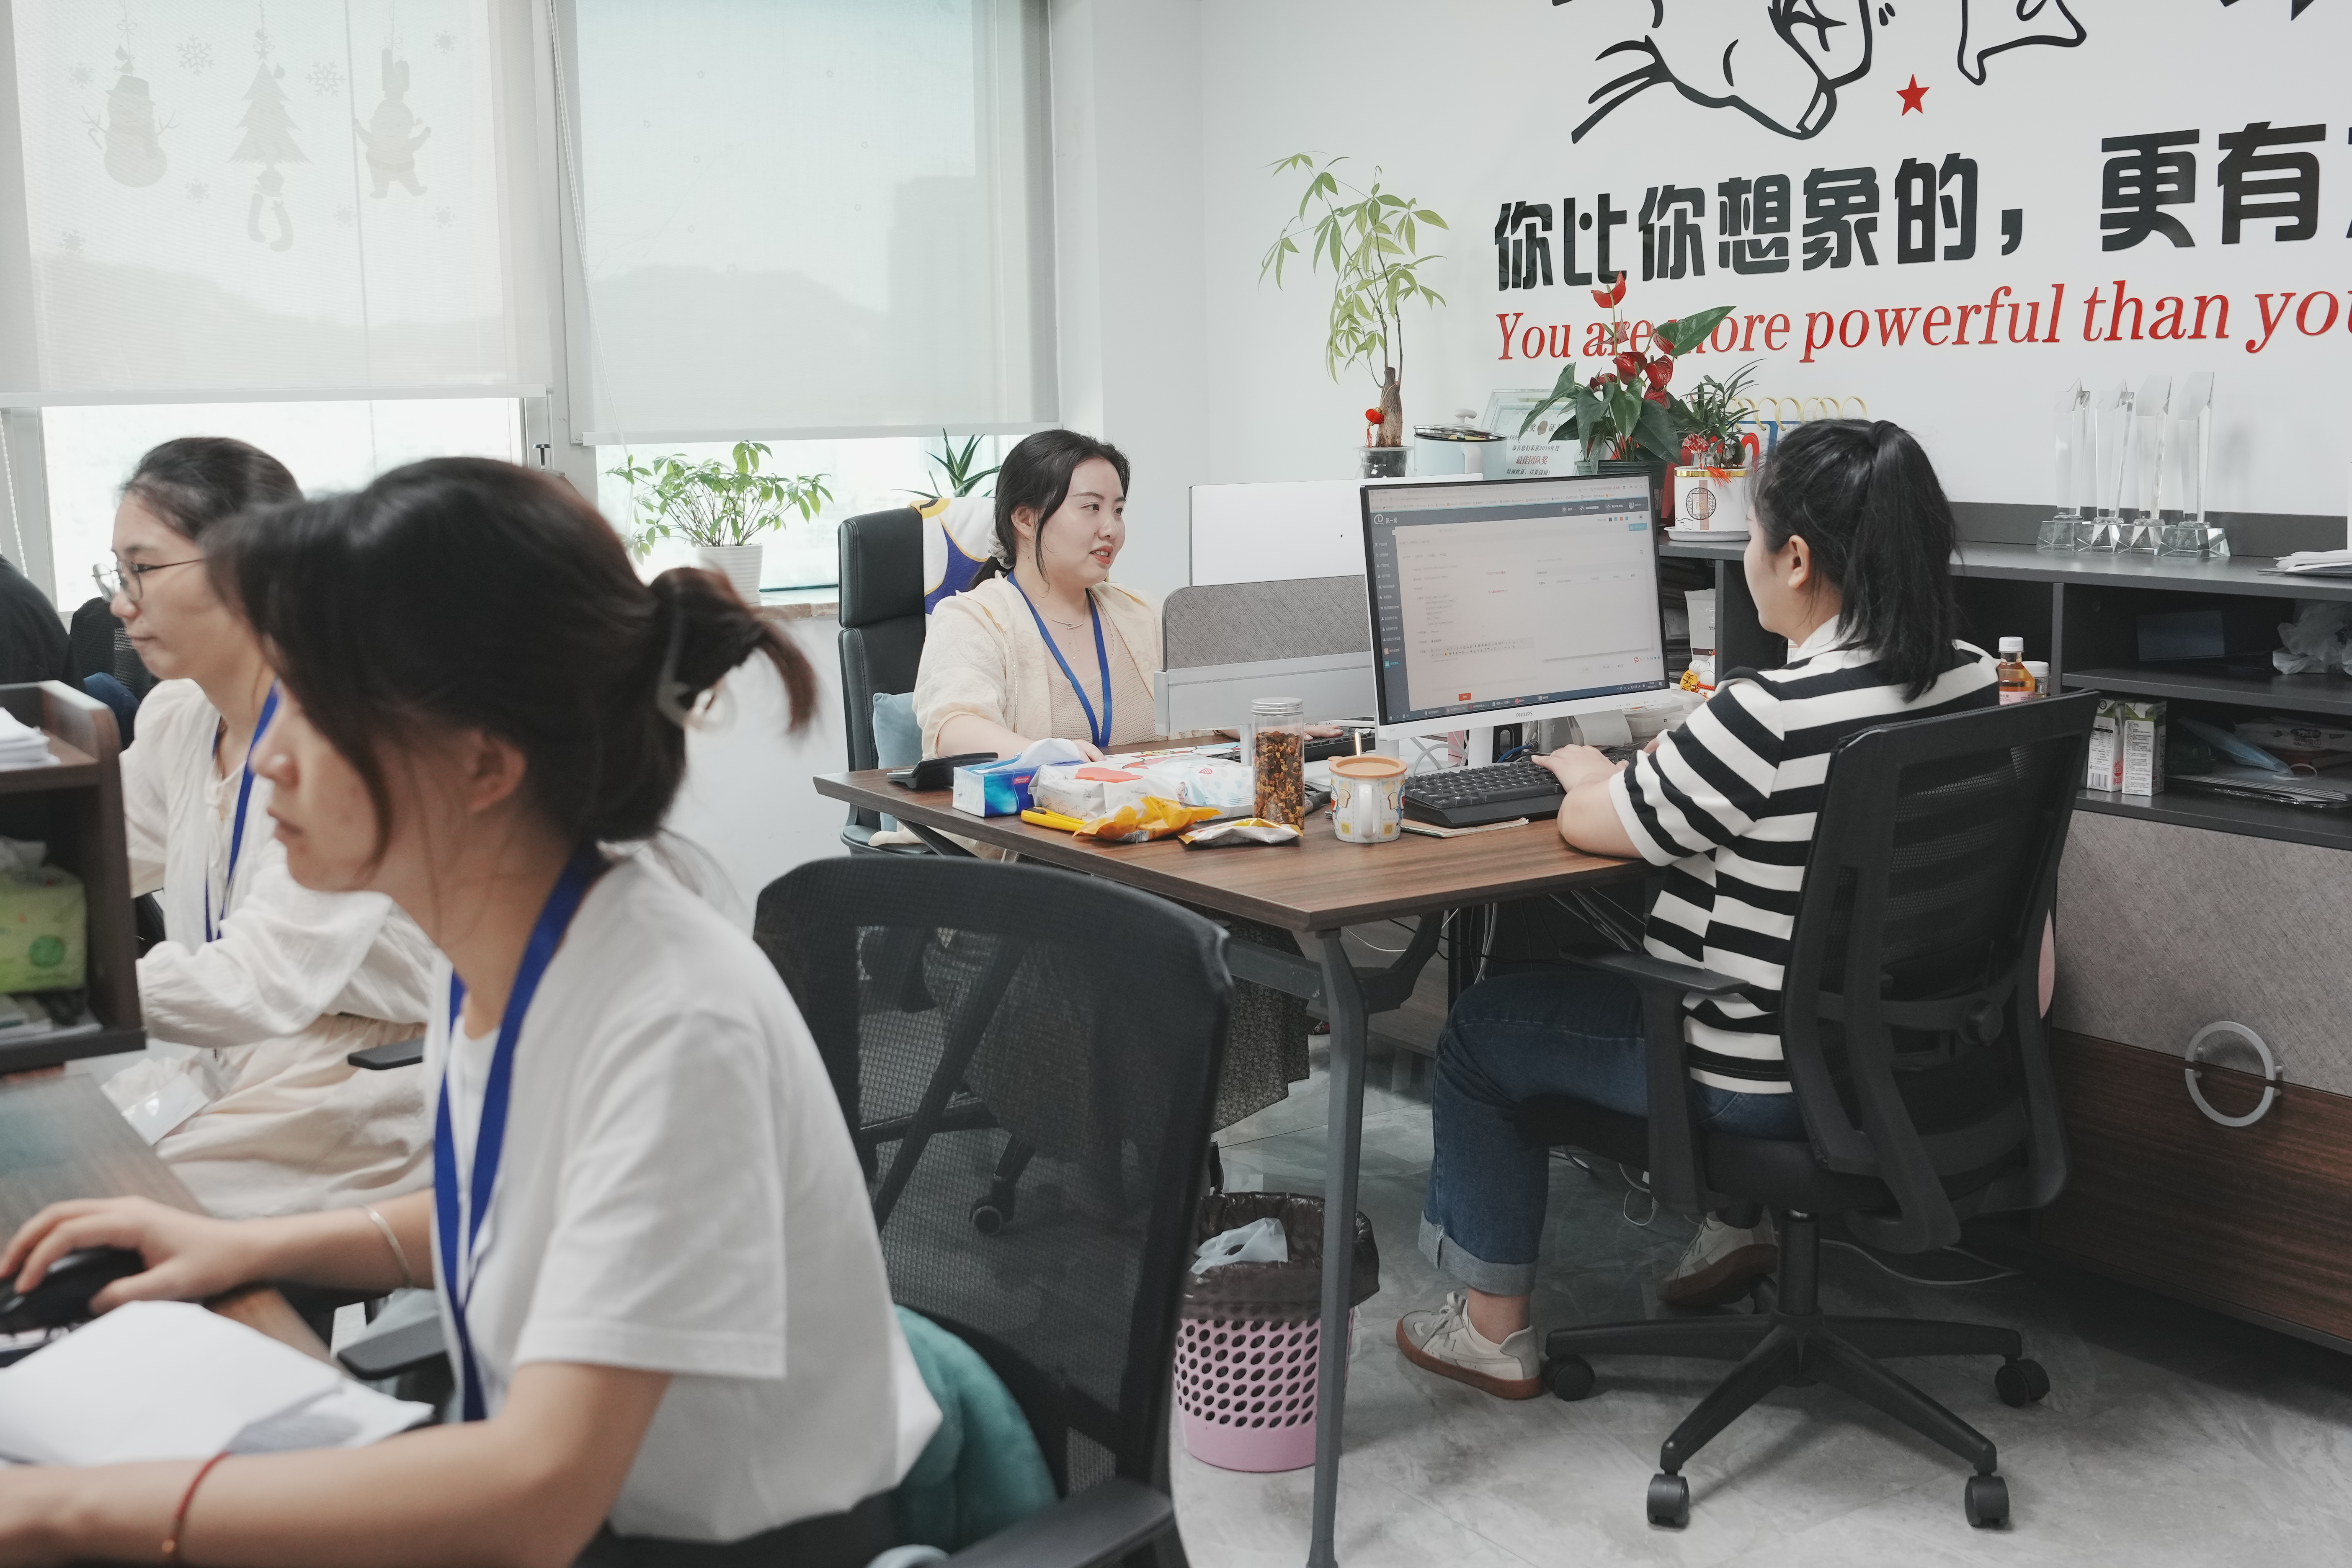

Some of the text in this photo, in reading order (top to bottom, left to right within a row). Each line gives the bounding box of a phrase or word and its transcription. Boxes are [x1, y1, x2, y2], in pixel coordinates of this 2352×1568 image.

[1495, 121, 2352, 291] 你比你想象的，更有
[1496, 312, 1571, 360] You
[1663, 313, 1790, 354] ore
[1799, 284, 2065, 363] powerful
[2083, 280, 2229, 341] than
[2246, 291, 2352, 353] yo
[1516, 455, 1548, 465] 最佳团队奖
